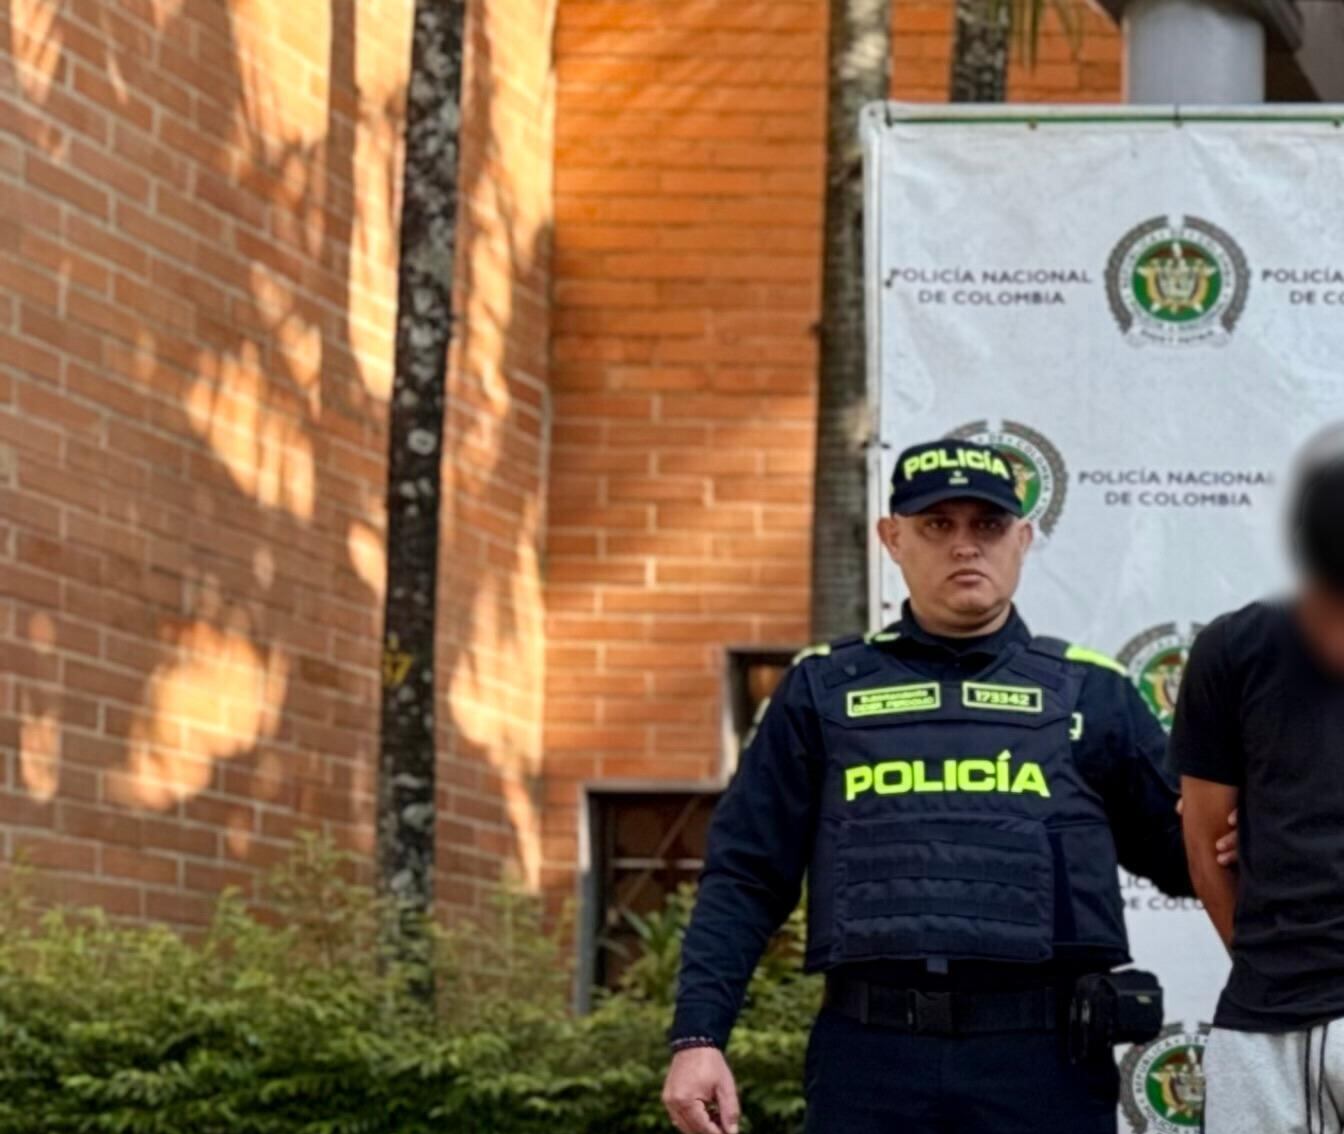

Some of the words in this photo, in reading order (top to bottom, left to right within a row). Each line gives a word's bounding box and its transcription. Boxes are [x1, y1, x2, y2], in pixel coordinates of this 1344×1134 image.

[888, 266, 976, 285] POLICÍA
[981, 269, 1092, 285] NACIONAL
[917, 289, 946, 305] DE
[952, 290, 1065, 306] COLOMBIA
[1289, 290, 1316, 305] DE
[1077, 467, 1162, 485] POLICÍA
[1104, 490, 1132, 506] DE
[1138, 491, 1252, 507] COLOMBIA
[845, 749, 1051, 801] POLICÍA
